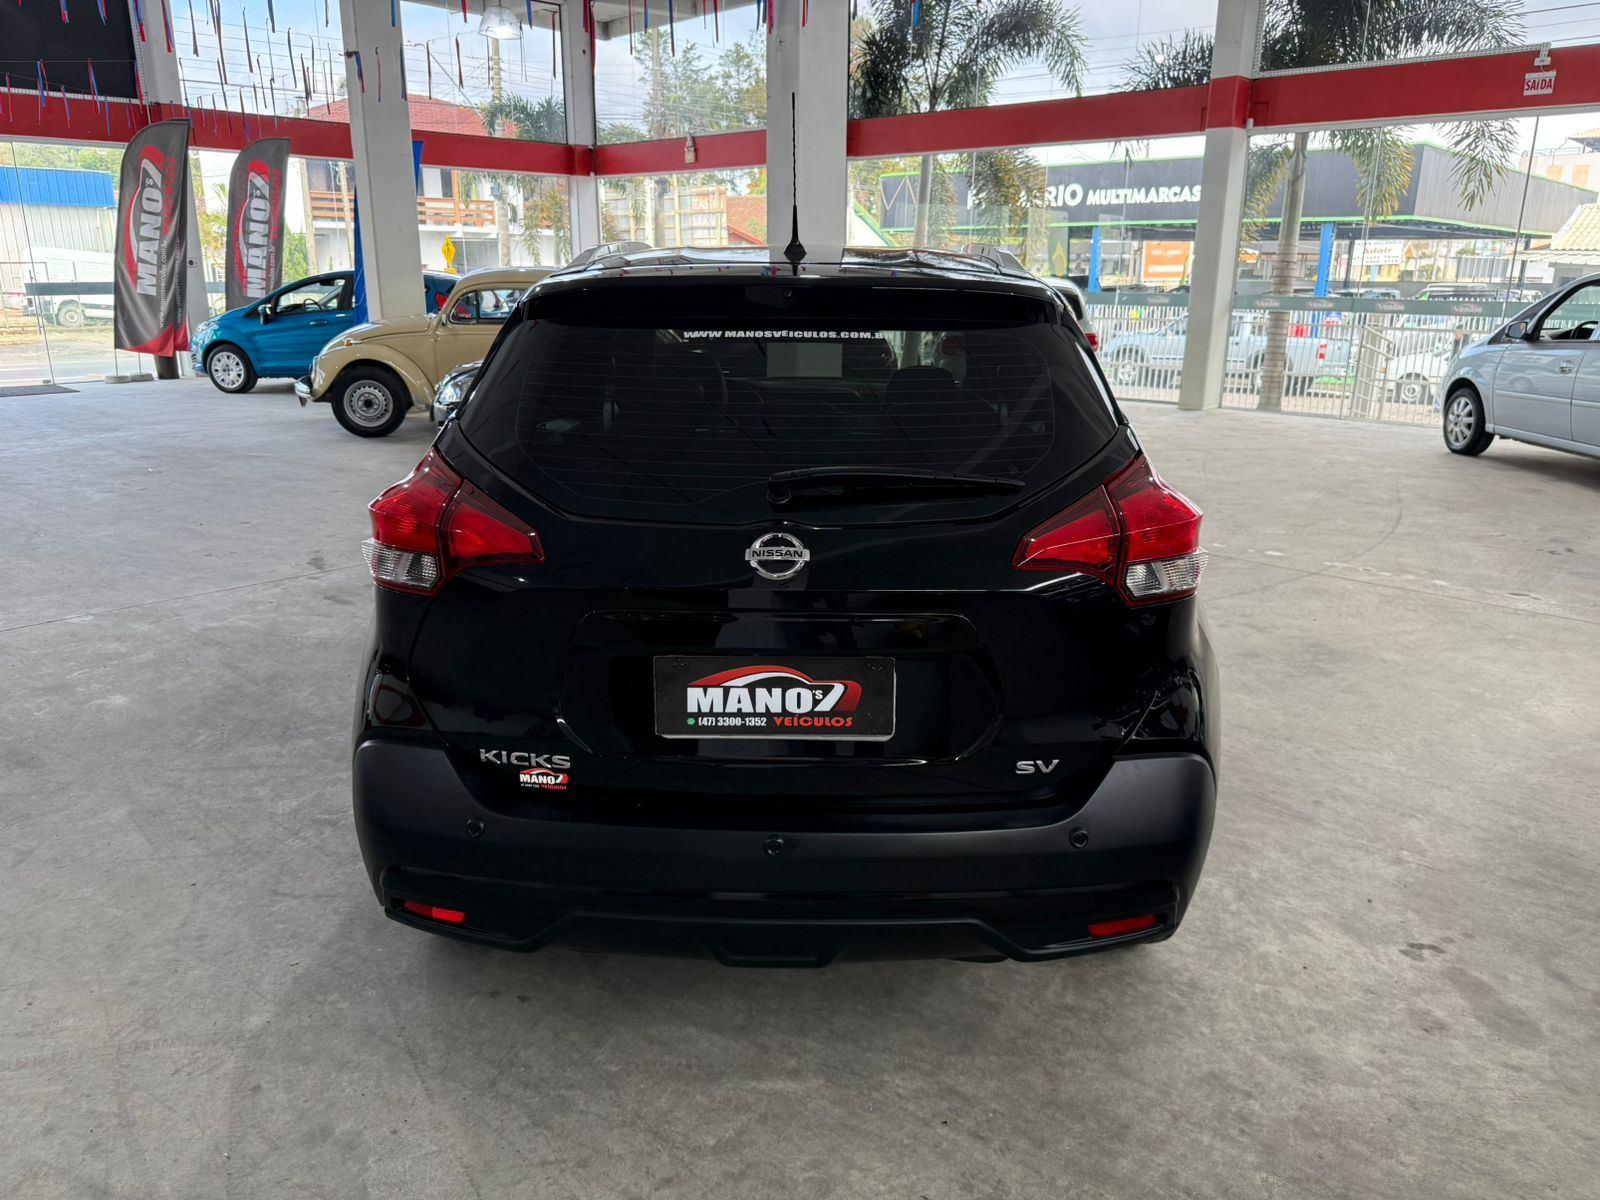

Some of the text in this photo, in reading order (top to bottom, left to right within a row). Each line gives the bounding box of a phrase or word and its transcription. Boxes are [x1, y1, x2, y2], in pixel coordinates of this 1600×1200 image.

[1086, 185, 1201, 206] MULTIMARCAS
[752, 549, 803, 558] NISSAN
[698, 716, 767, 727] (47) 3300-1352
[773, 714, 854, 727] VEÍCULOS
[479, 748, 571, 769] KICKS
[1015, 759, 1060, 774] SV
